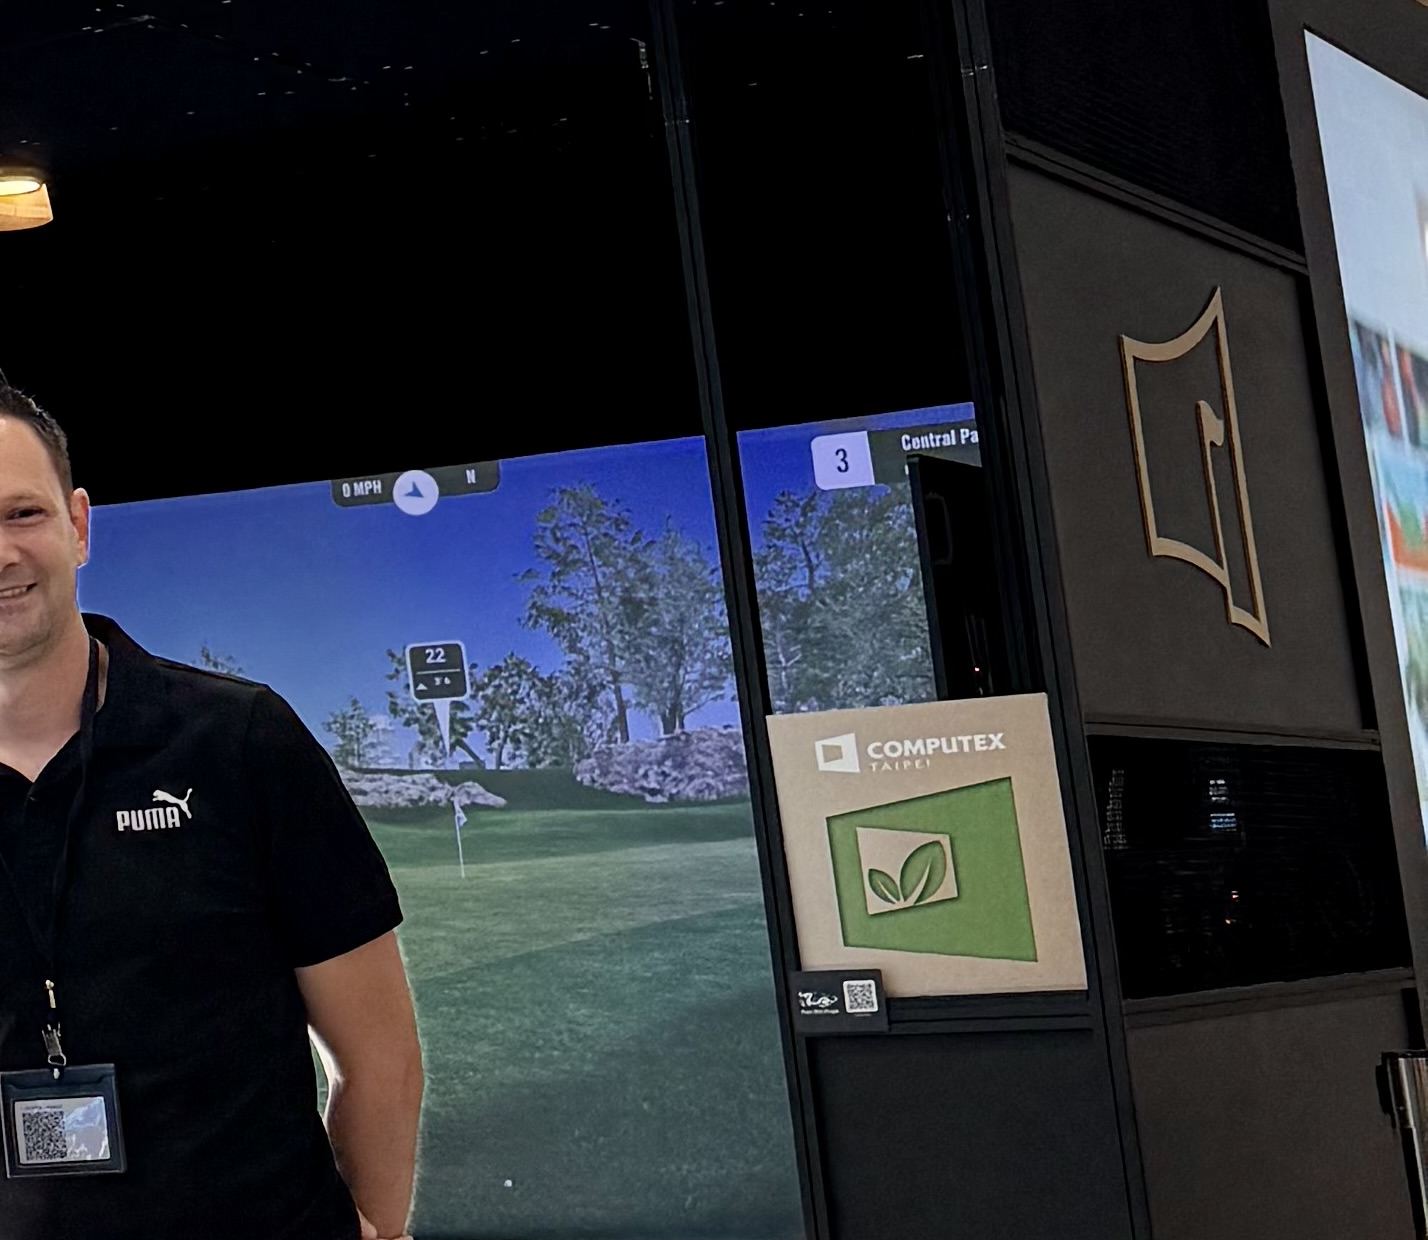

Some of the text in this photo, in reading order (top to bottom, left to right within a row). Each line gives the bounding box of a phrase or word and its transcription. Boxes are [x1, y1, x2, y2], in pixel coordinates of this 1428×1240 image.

[835, 448, 849, 473] 3
[901, 430, 956, 451] Central
[342, 469, 476, 498] 0 MPH N
[425, 648, 446, 663] 22
[867, 733, 1006, 759] COMPUTEX
[870, 758, 930, 772] TAIPEI
[116, 806, 181, 832] PUMA
